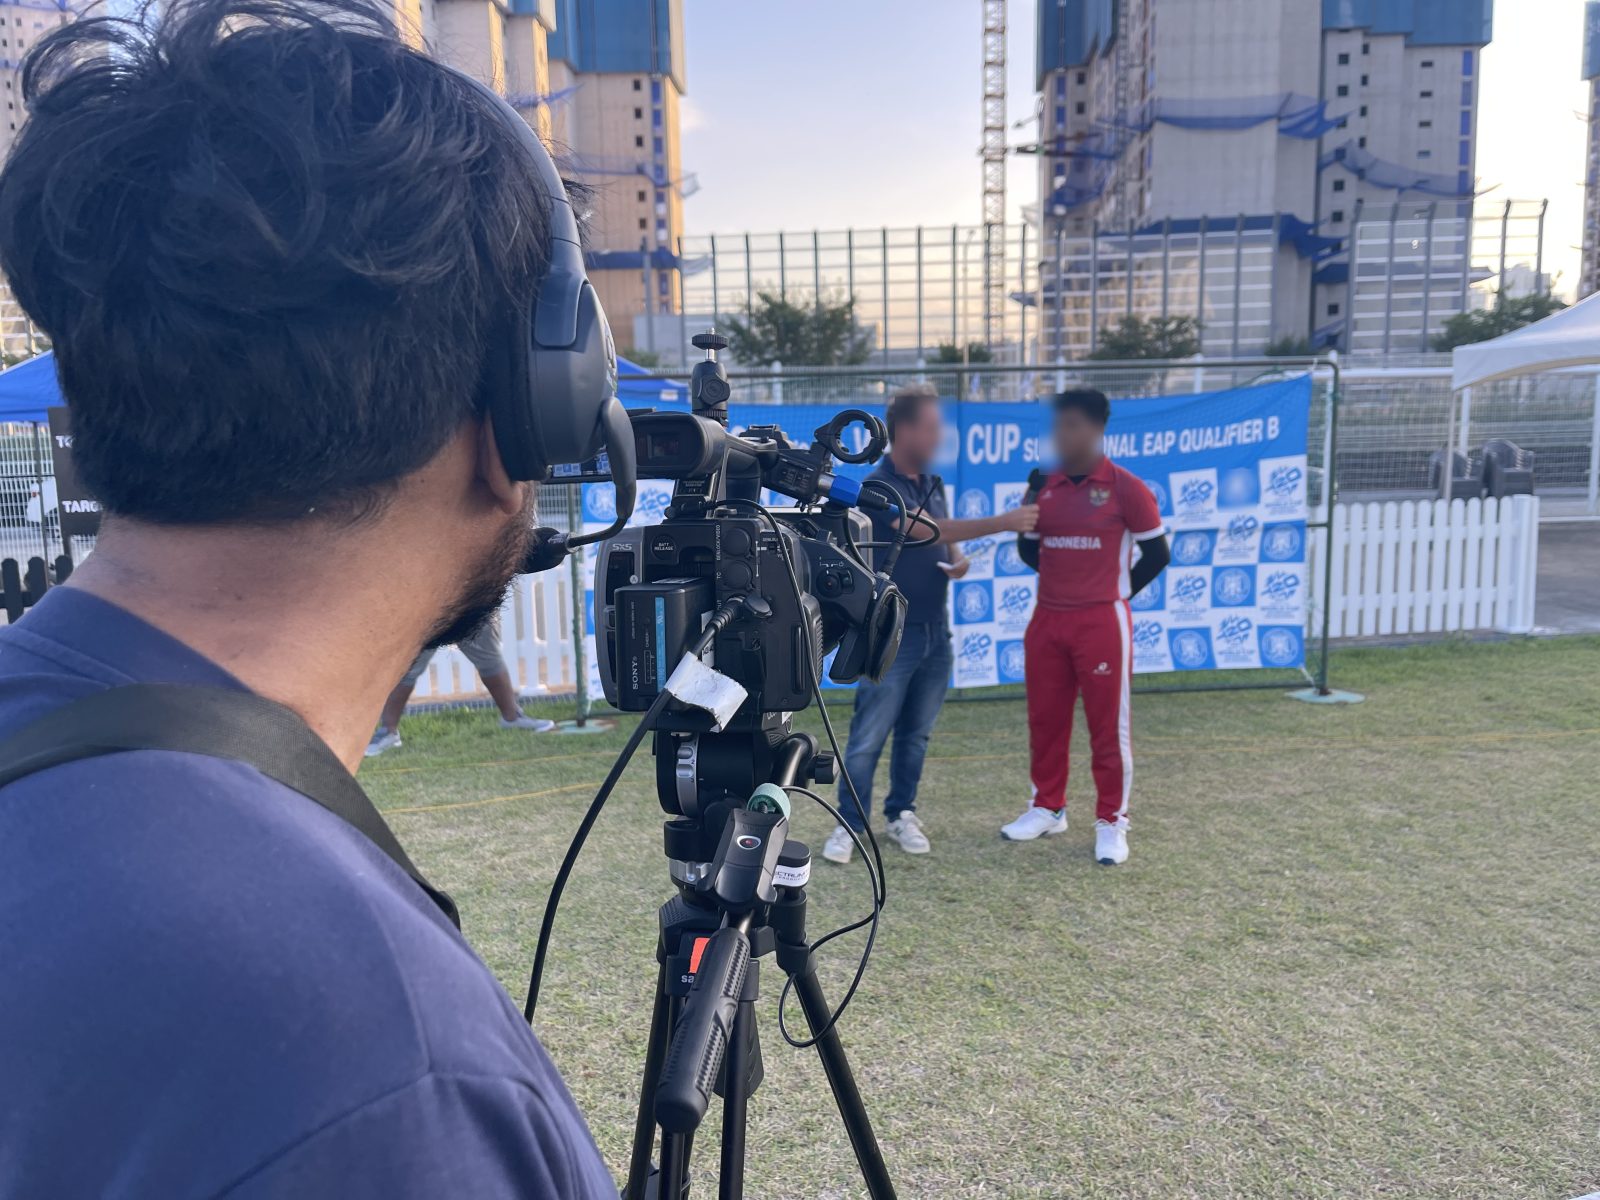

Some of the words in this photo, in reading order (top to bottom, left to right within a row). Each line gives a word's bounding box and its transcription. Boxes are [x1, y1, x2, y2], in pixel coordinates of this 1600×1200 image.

[967, 423, 1020, 464] CUP
[1143, 431, 1176, 456] EAP
[1179, 418, 1264, 453] QUALIFIER
[1267, 415, 1280, 439] B
